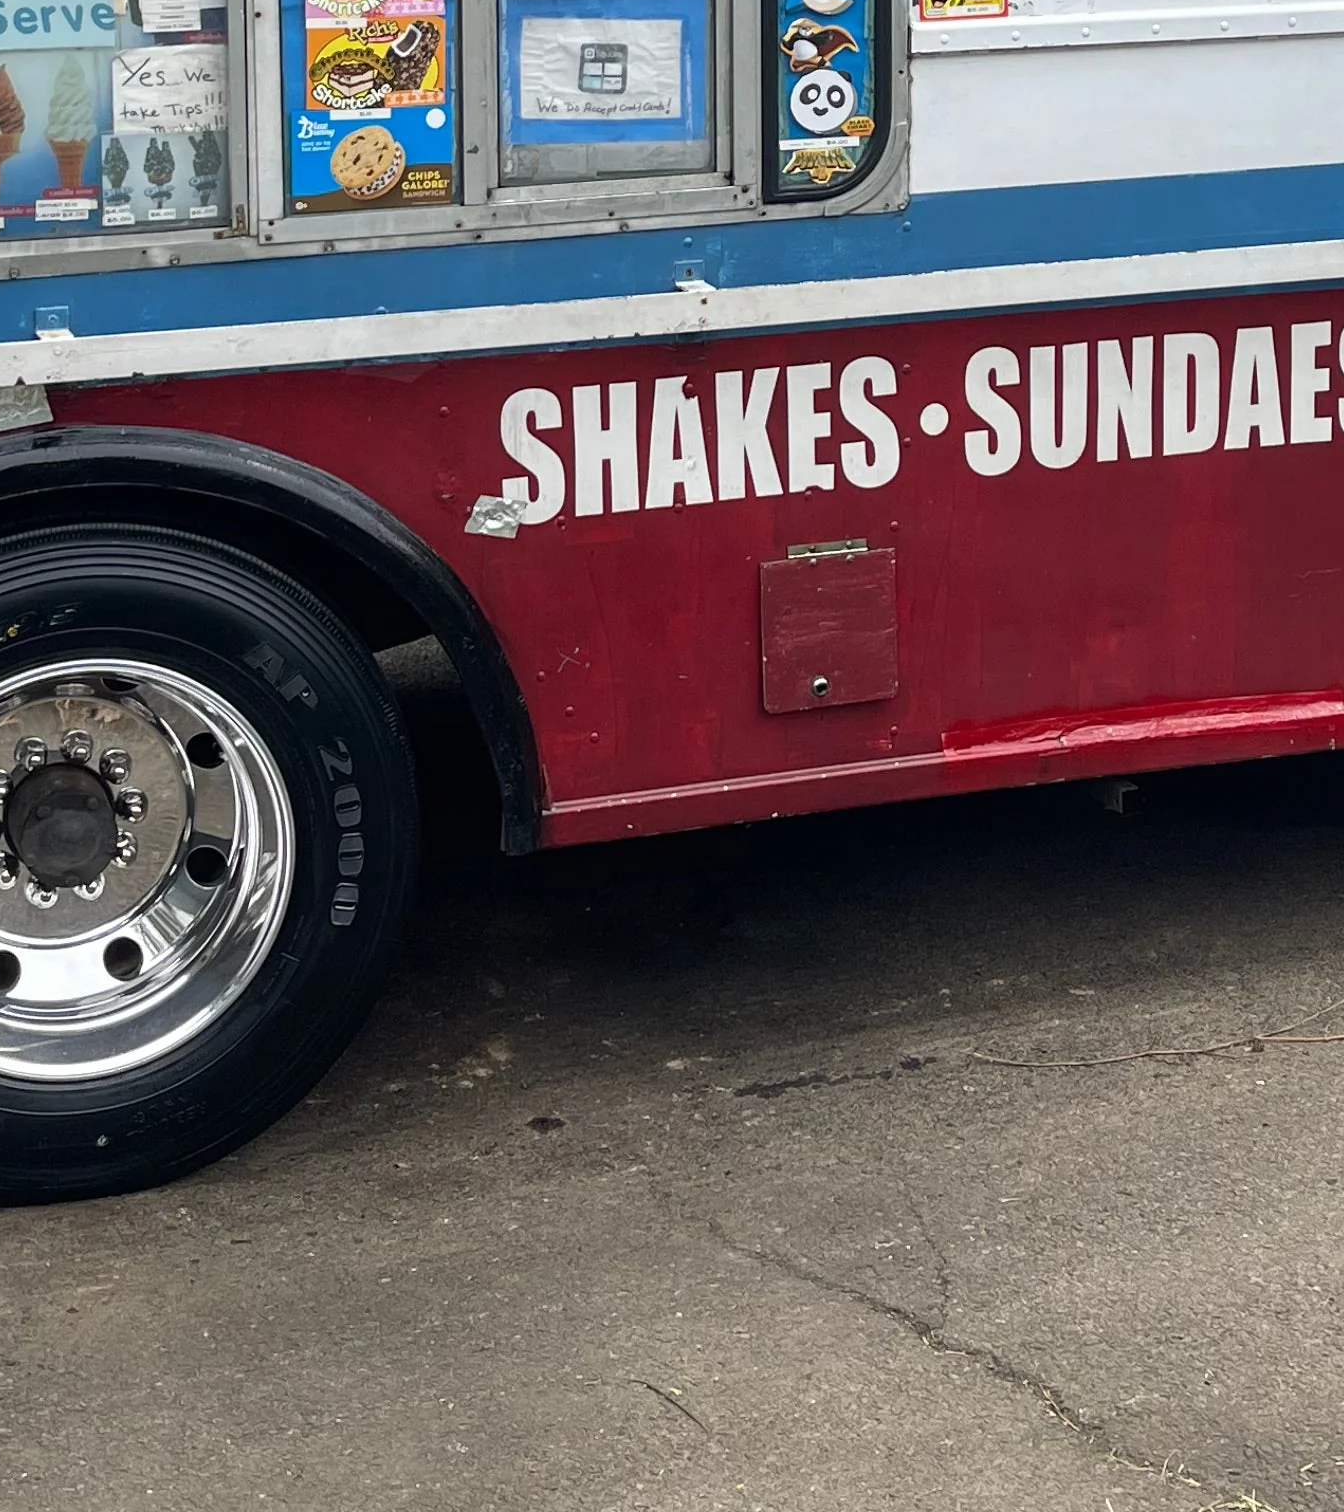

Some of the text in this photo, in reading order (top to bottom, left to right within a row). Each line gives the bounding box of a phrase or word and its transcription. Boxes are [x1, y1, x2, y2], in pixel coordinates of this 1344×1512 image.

[184, 68, 217, 83] We
[312, 82, 393, 109] Shortcake
[536, 96, 558, 113] We
[564, 102, 580, 112] Do
[119, 101, 161, 120] take
[407, 170, 441, 181] CHIPS
[402, 189, 446, 198] SANDWICH
[500, 355, 901, 527] SHAKES
[317, 739, 365, 927] 2000
